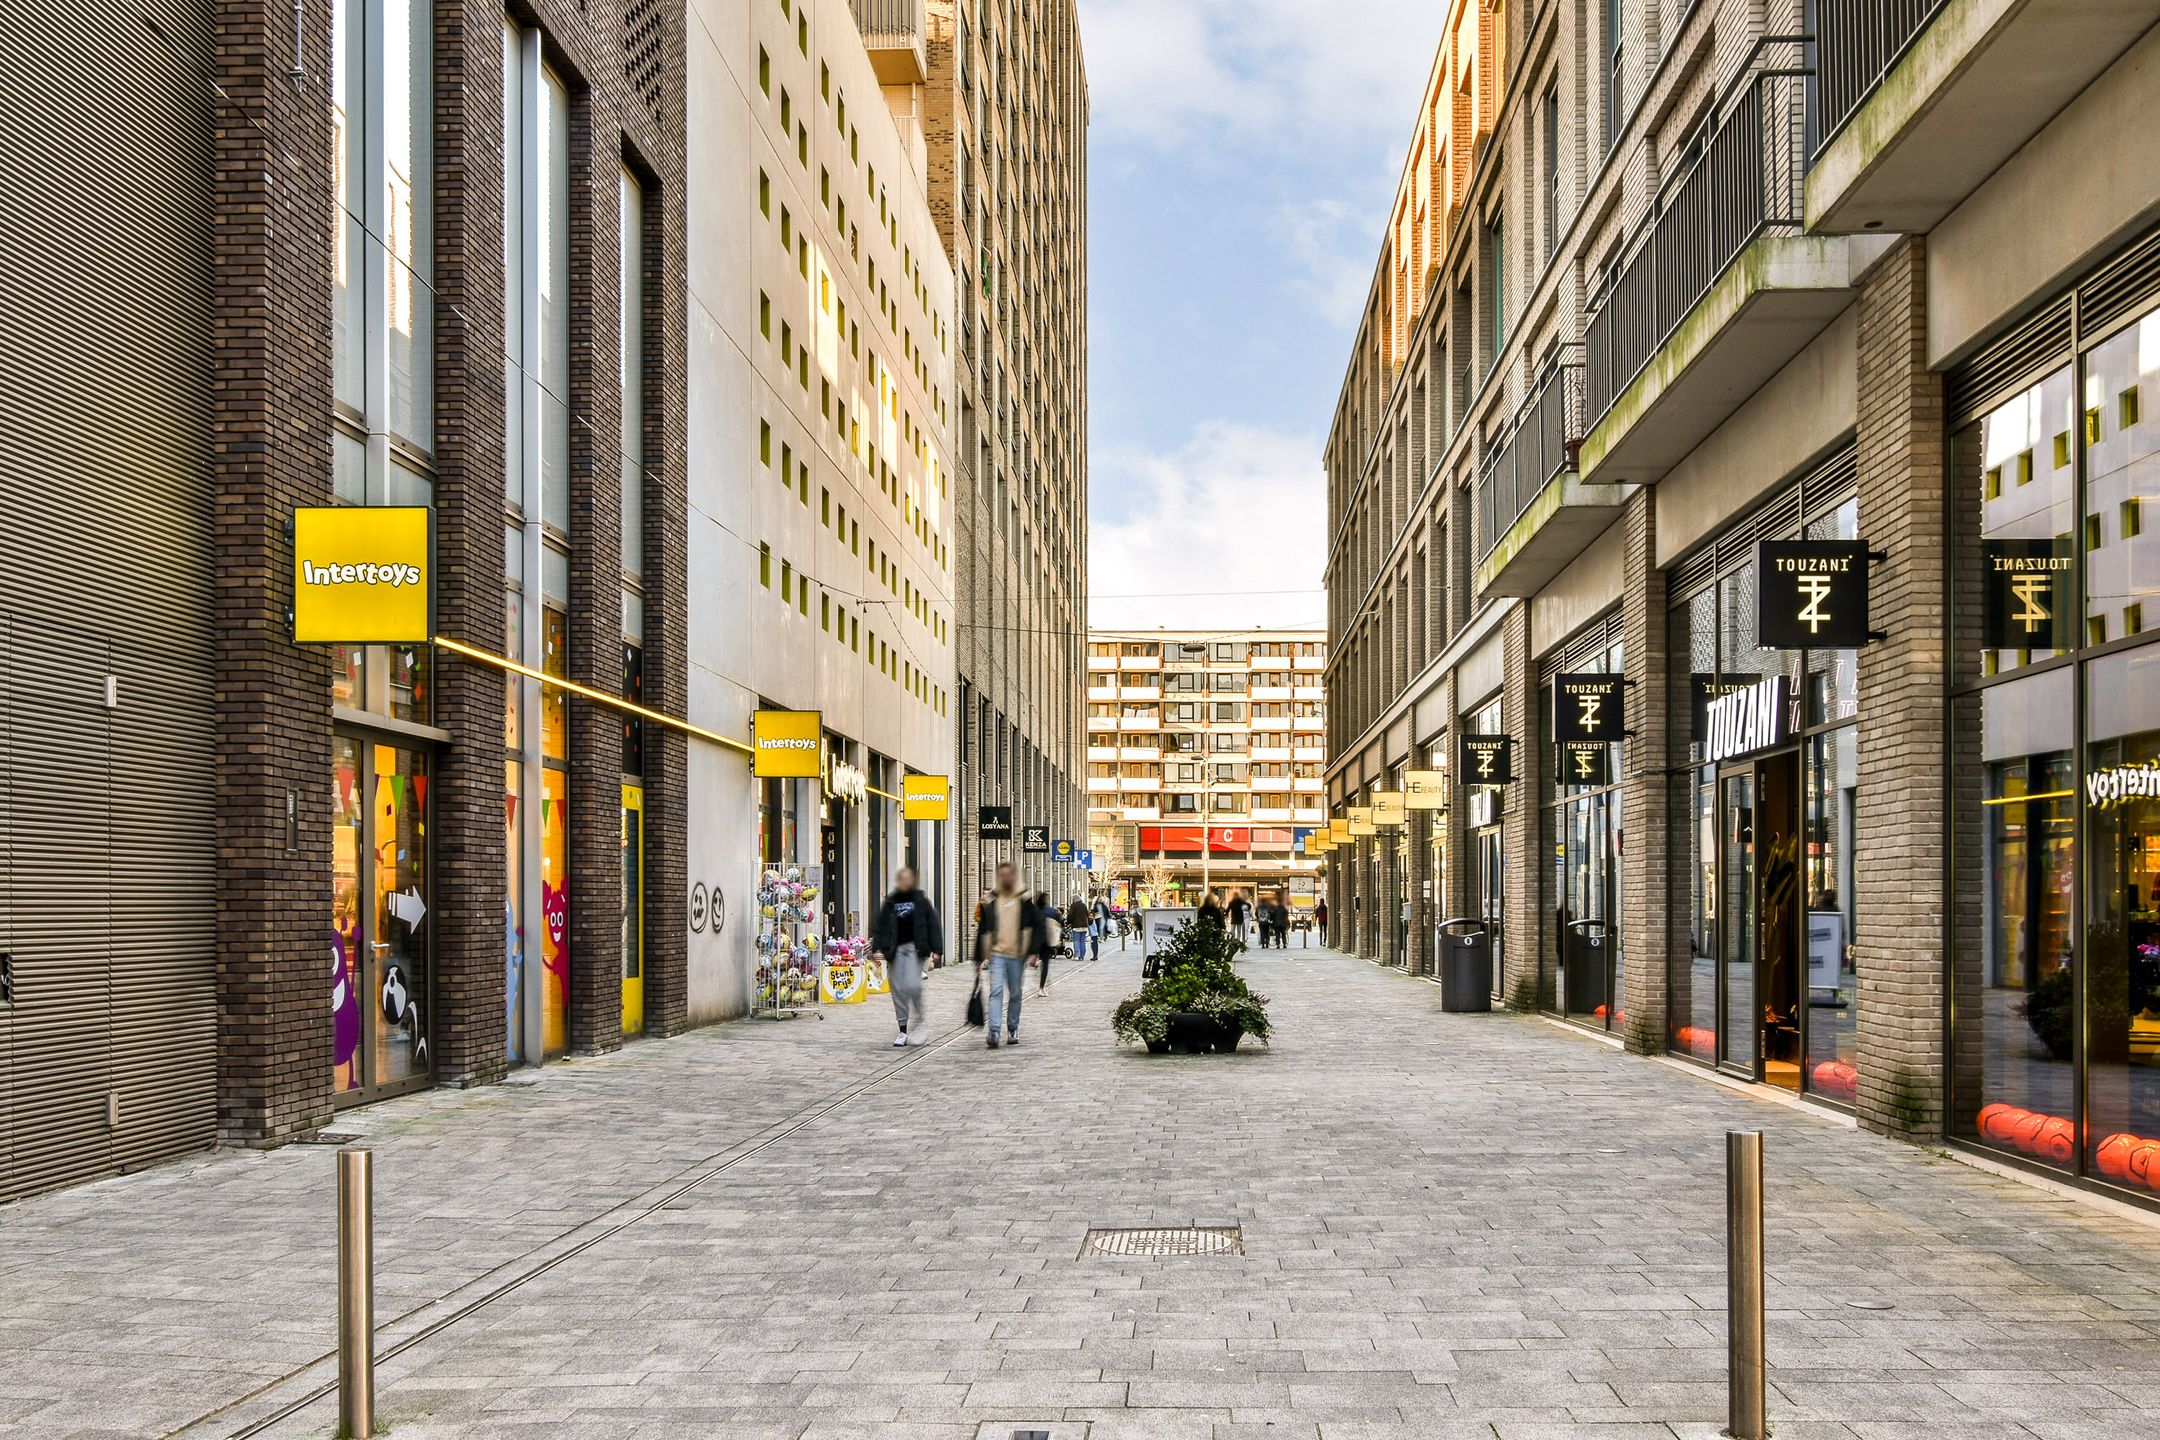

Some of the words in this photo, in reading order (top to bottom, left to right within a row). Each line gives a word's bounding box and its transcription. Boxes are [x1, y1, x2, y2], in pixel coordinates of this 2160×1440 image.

[1776, 558, 1850, 572] TOUZANI
[302, 559, 421, 588] Intertoys
[1565, 684, 1612, 694] TOUZANI
[1705, 675, 1780, 763] TOUZANI
[758, 736, 817, 751] Intertoys
[1467, 742, 1502, 750] TOUZANI
[906, 793, 945, 802] Intertoys
[1082, 851, 1089, 860] P
[830, 967, 855, 980] Stunt
[832, 977, 852, 989] prijs
